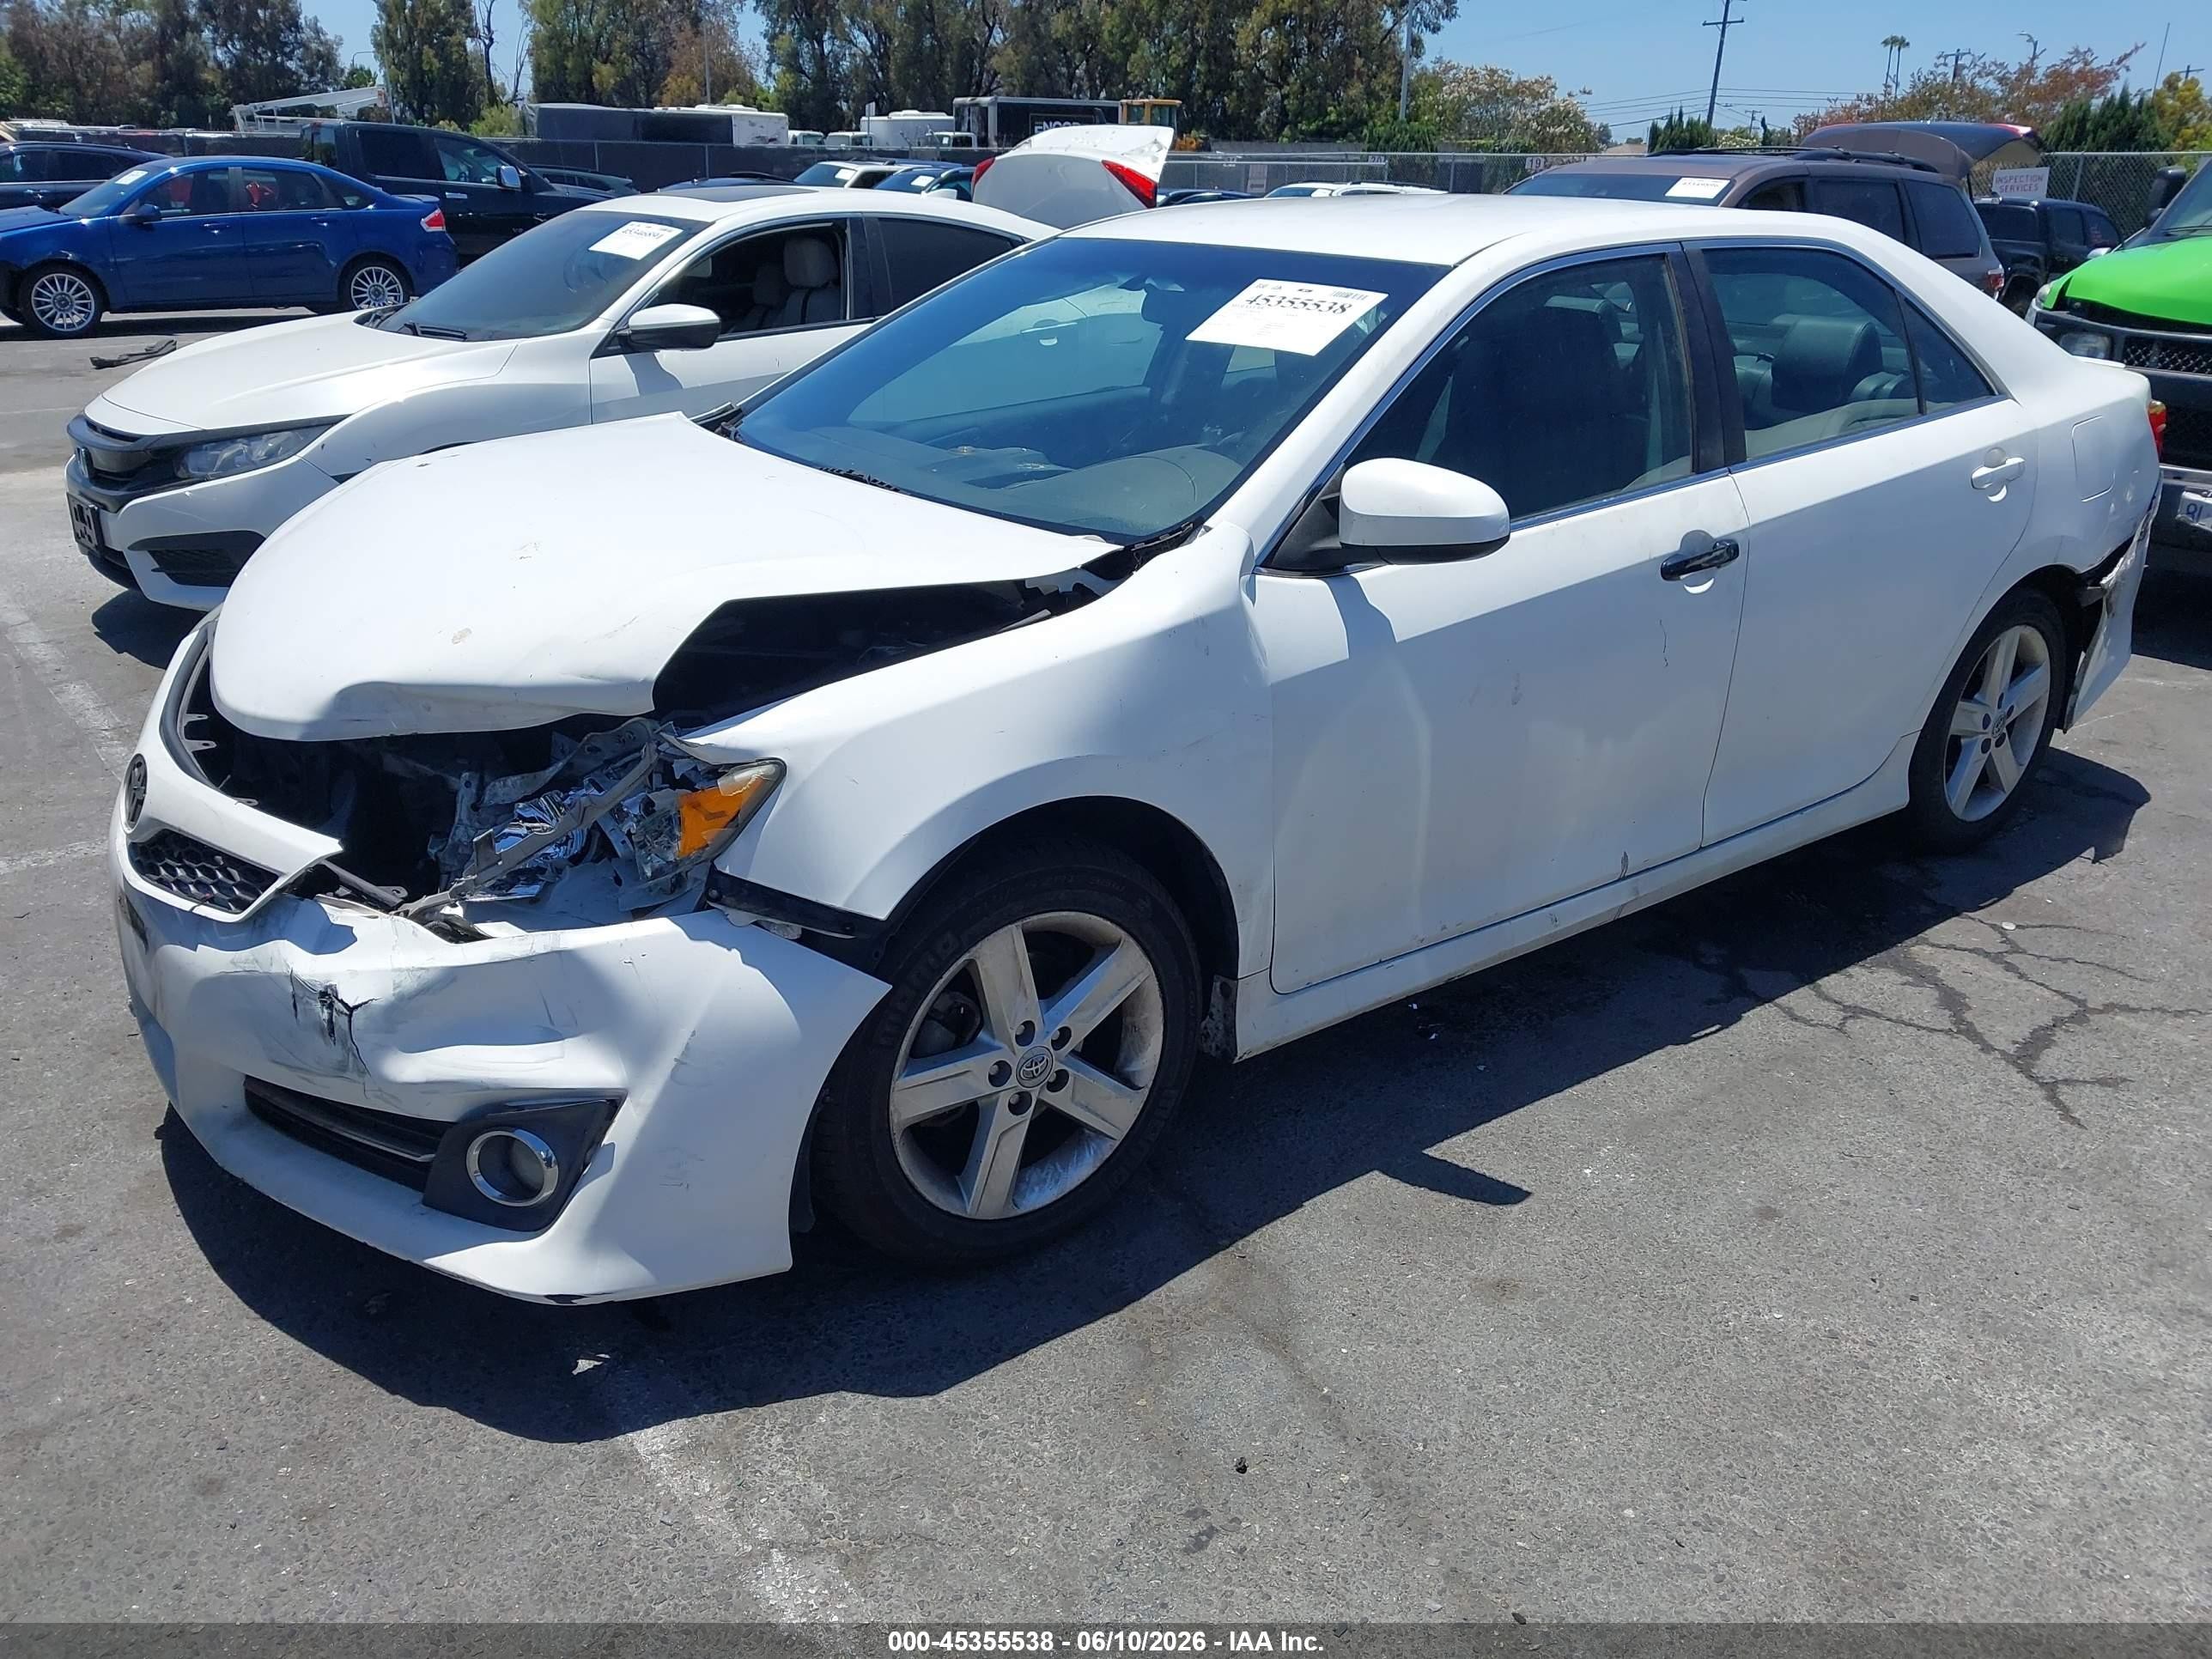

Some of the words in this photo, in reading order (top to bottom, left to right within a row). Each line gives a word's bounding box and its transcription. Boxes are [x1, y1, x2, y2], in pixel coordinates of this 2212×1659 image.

[1996, 173, 2044, 184] INSPECTION
[1999, 183, 2039, 193] SERVICES
[1245, 294, 1352, 314] 45355538
